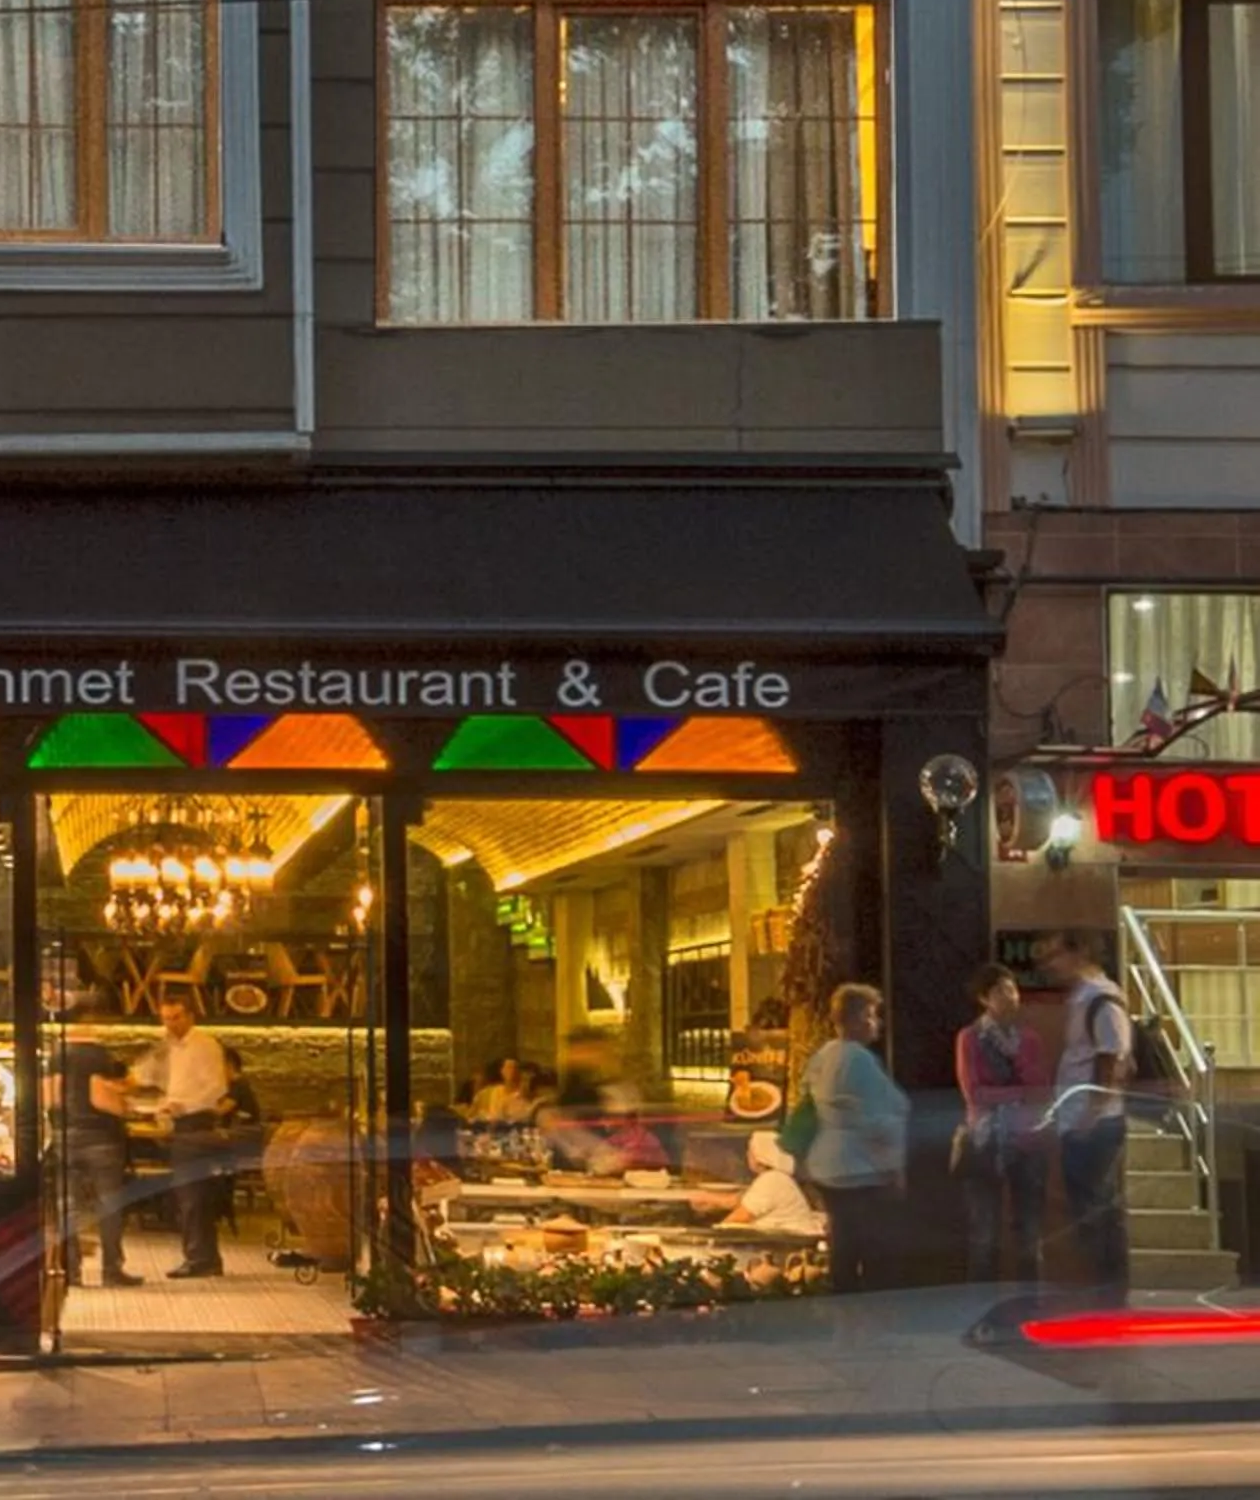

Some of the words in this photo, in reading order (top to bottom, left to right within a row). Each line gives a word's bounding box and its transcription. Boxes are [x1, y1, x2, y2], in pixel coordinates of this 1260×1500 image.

[176, 659, 518, 706] Restaurant
[557, 660, 600, 707] &
[644, 660, 791, 707] Cafe
